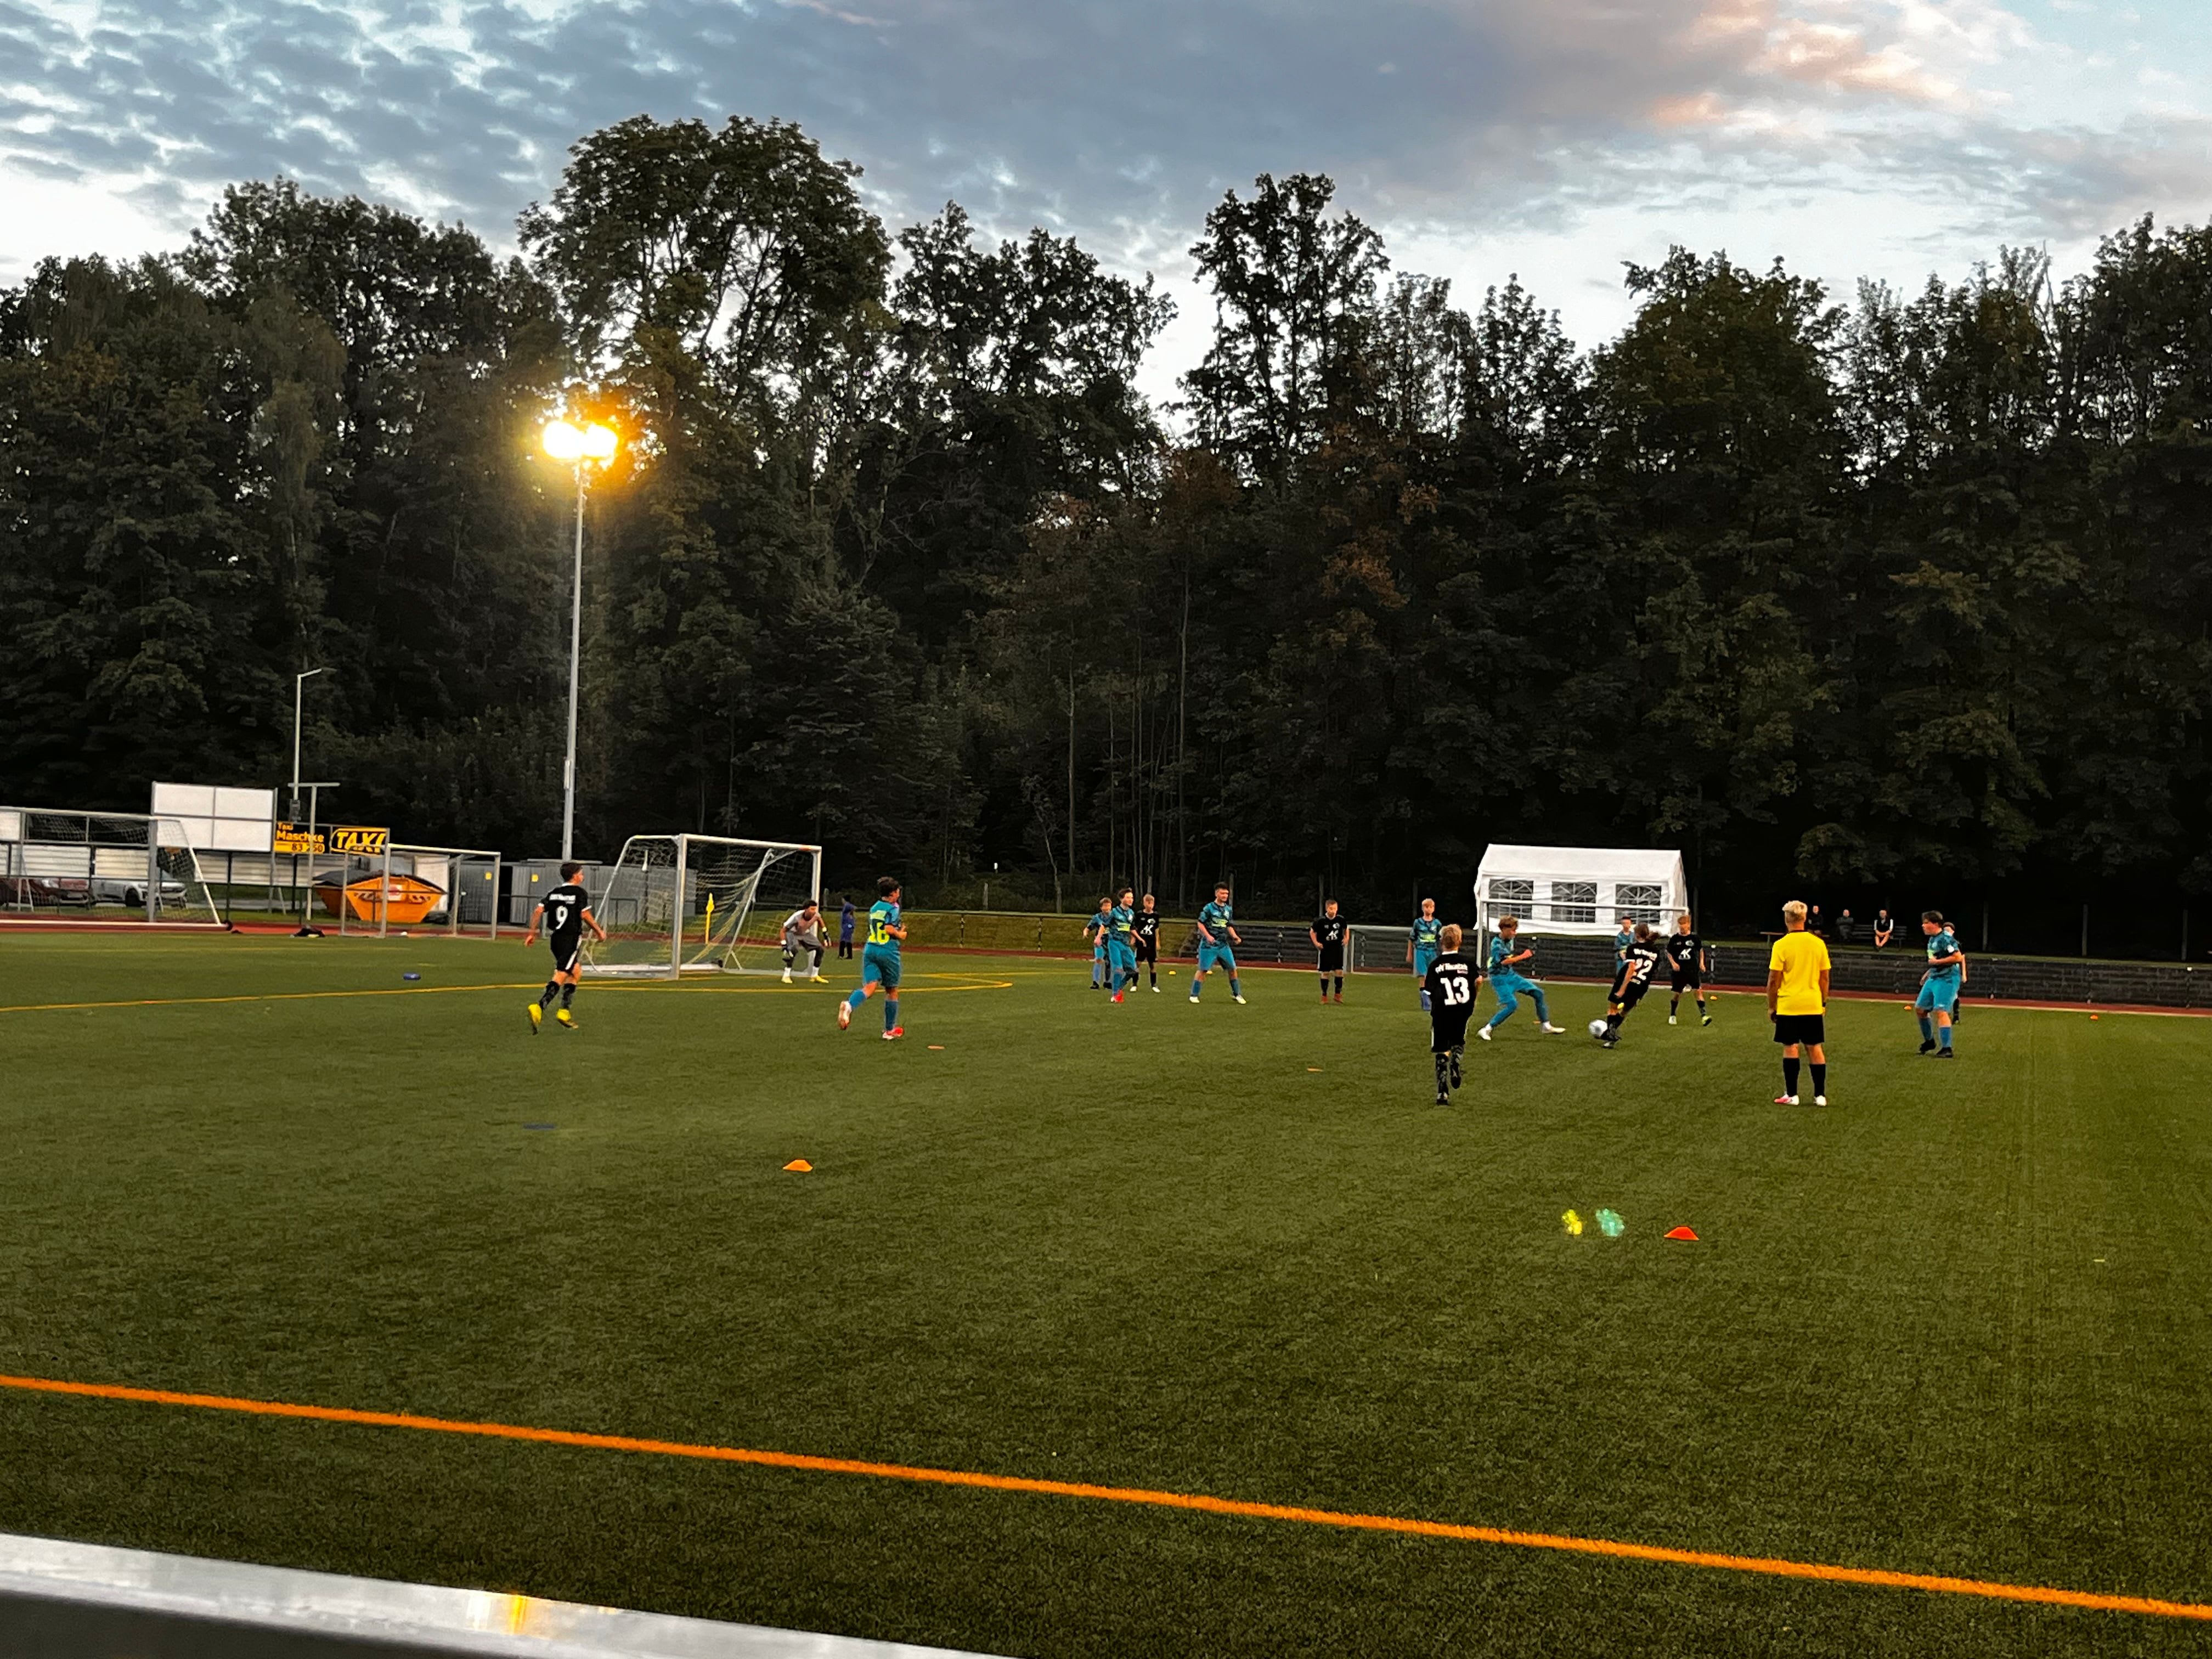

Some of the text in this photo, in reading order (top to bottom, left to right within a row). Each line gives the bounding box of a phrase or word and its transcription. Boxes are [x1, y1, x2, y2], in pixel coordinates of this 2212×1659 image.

[337, 832, 386, 853] TAXI
[555, 905, 568, 929] 9
[1440, 977, 1470, 1006] 13
